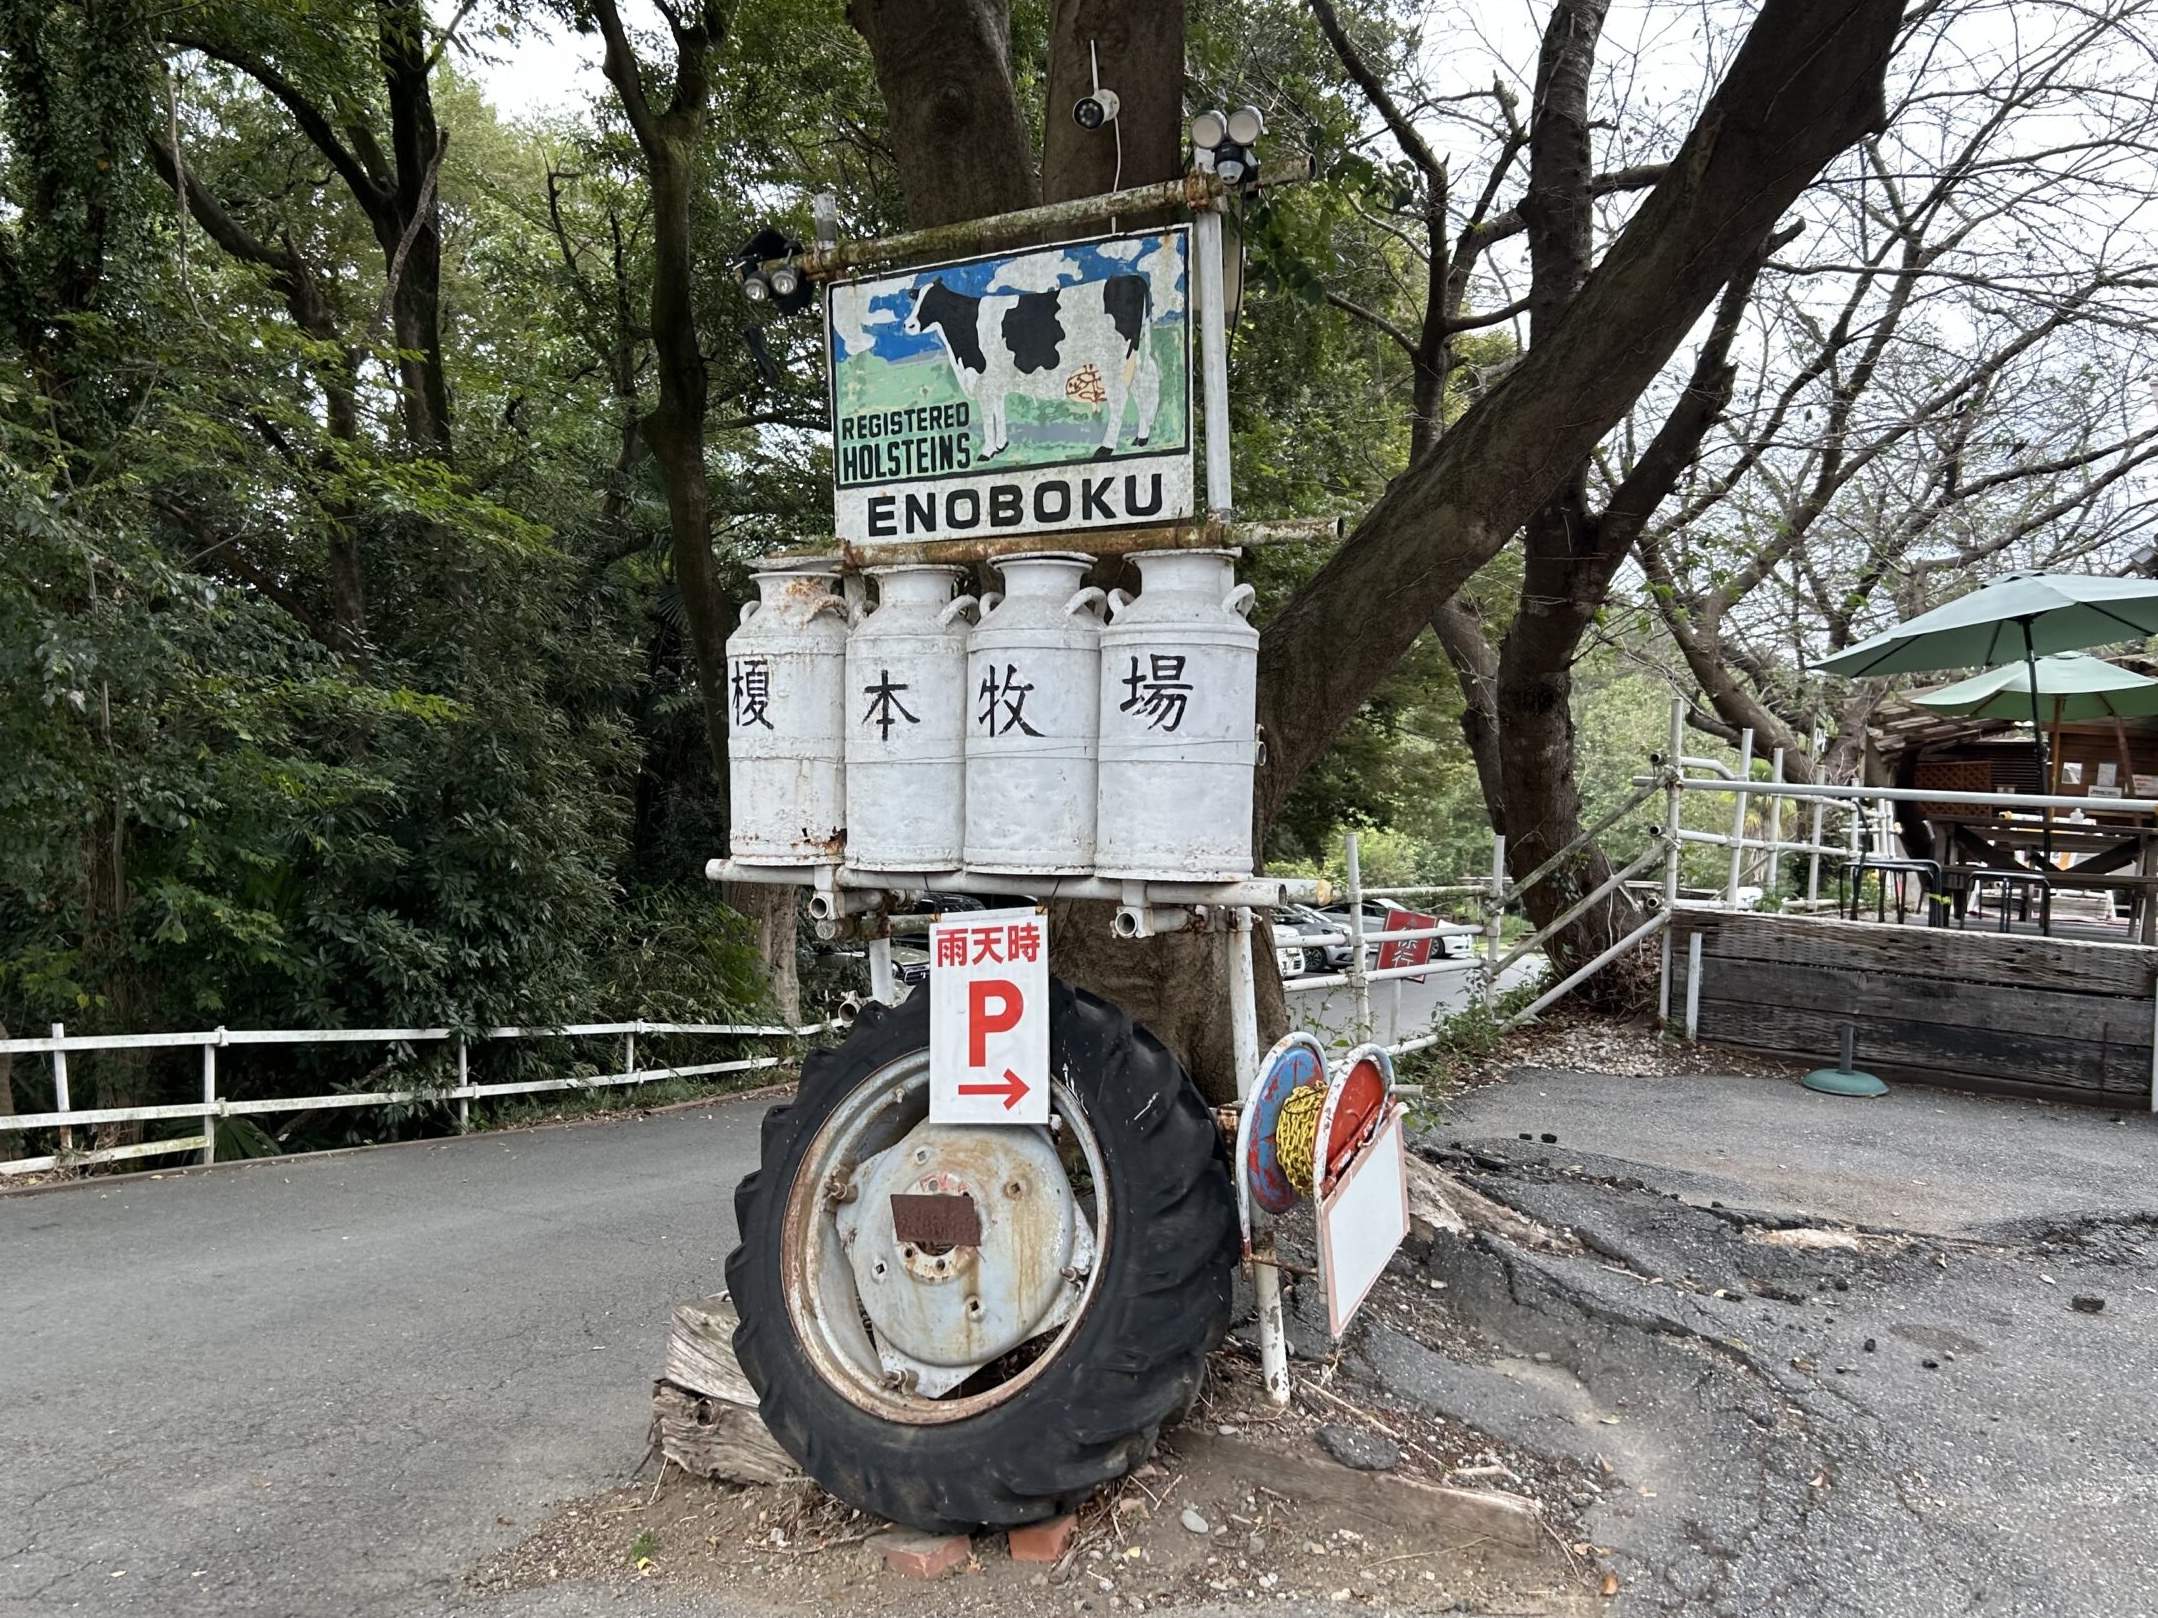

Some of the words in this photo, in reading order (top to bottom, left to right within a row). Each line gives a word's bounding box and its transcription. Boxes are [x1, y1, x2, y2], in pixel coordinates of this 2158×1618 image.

[842, 403, 970, 440] REGISTERED
[843, 434, 971, 482] HOLSTEINS
[868, 474, 1163, 536] ENOBOKU
[731, 654, 1194, 741] 榎本牧場
[936, 922, 1041, 967] 雨天時
[969, 980, 1024, 1067] P
